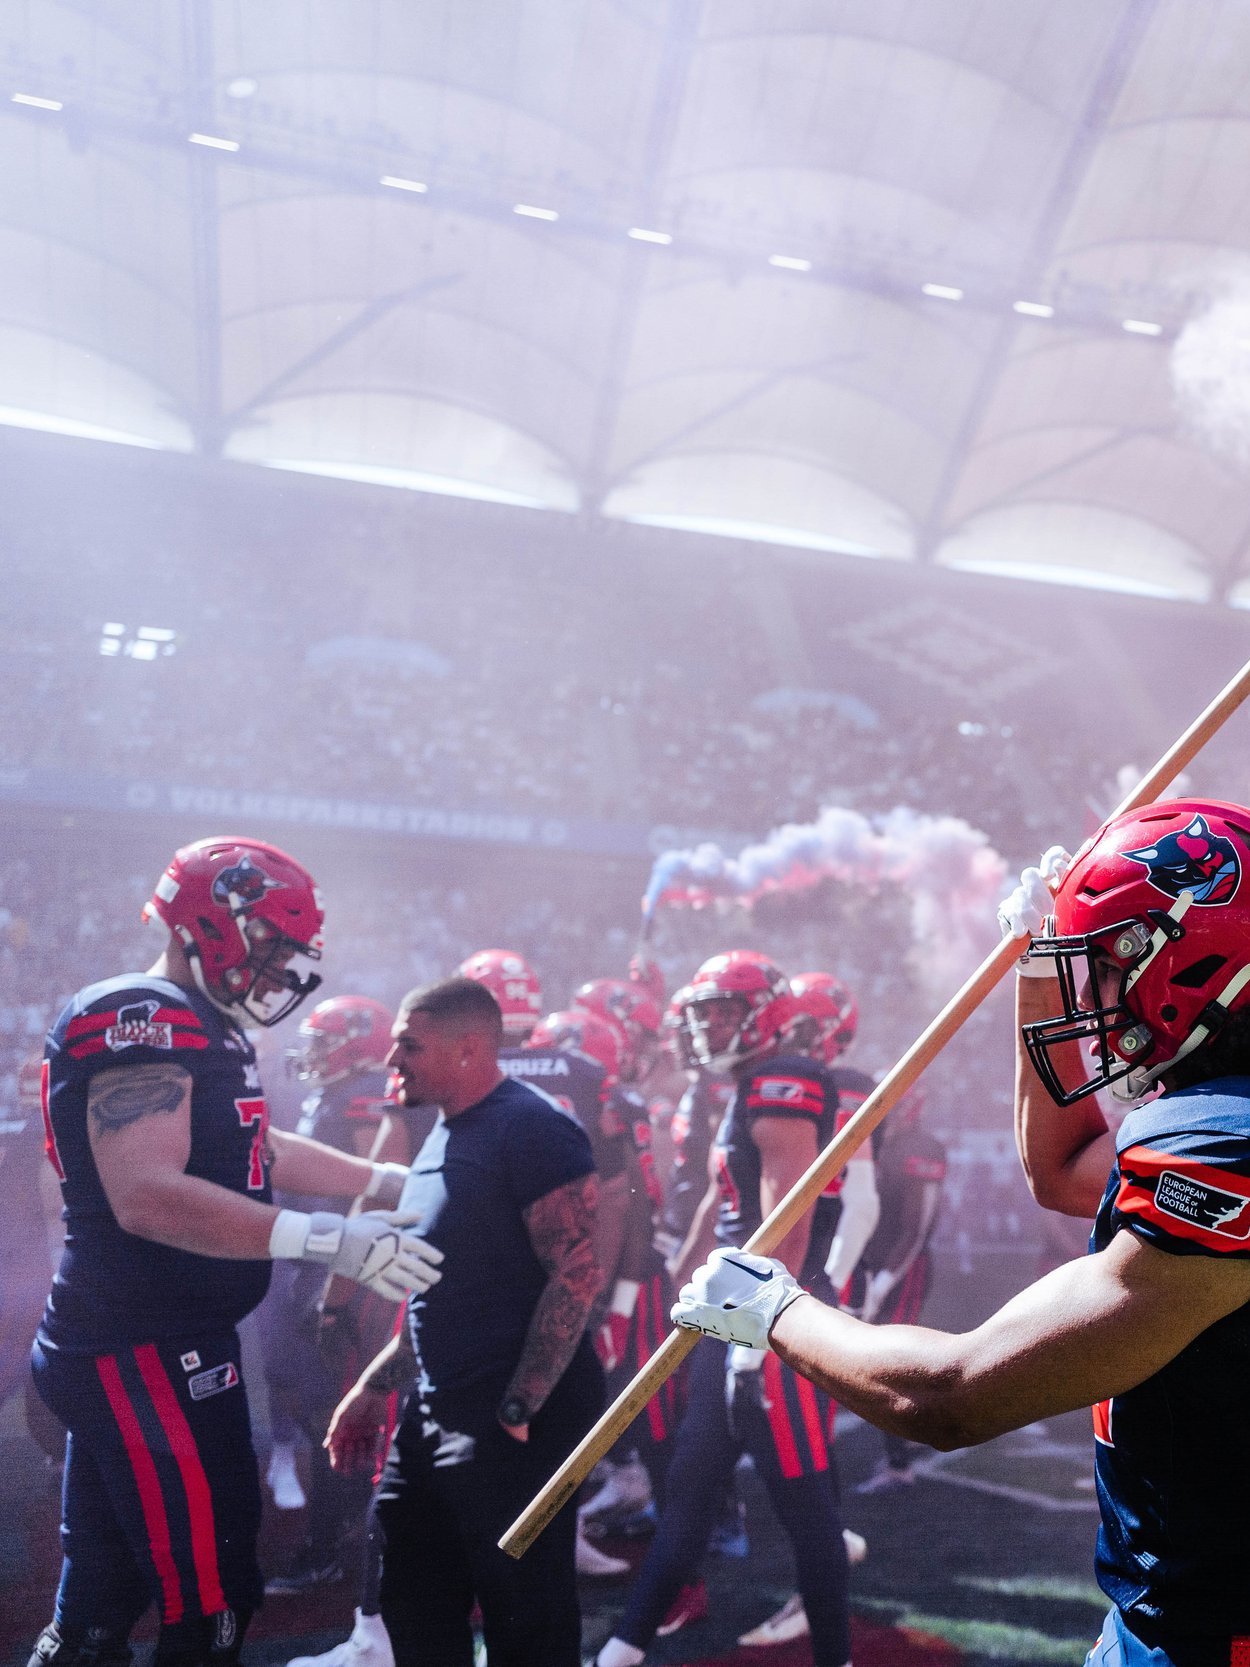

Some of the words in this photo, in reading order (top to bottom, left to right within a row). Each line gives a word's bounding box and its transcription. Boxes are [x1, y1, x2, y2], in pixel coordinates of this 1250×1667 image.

[1161, 1184, 1192, 1206] LEAGUE
[1163, 1176, 1208, 1201] EUROPEAN
[1158, 1193, 1199, 1217] FOOTBALL
